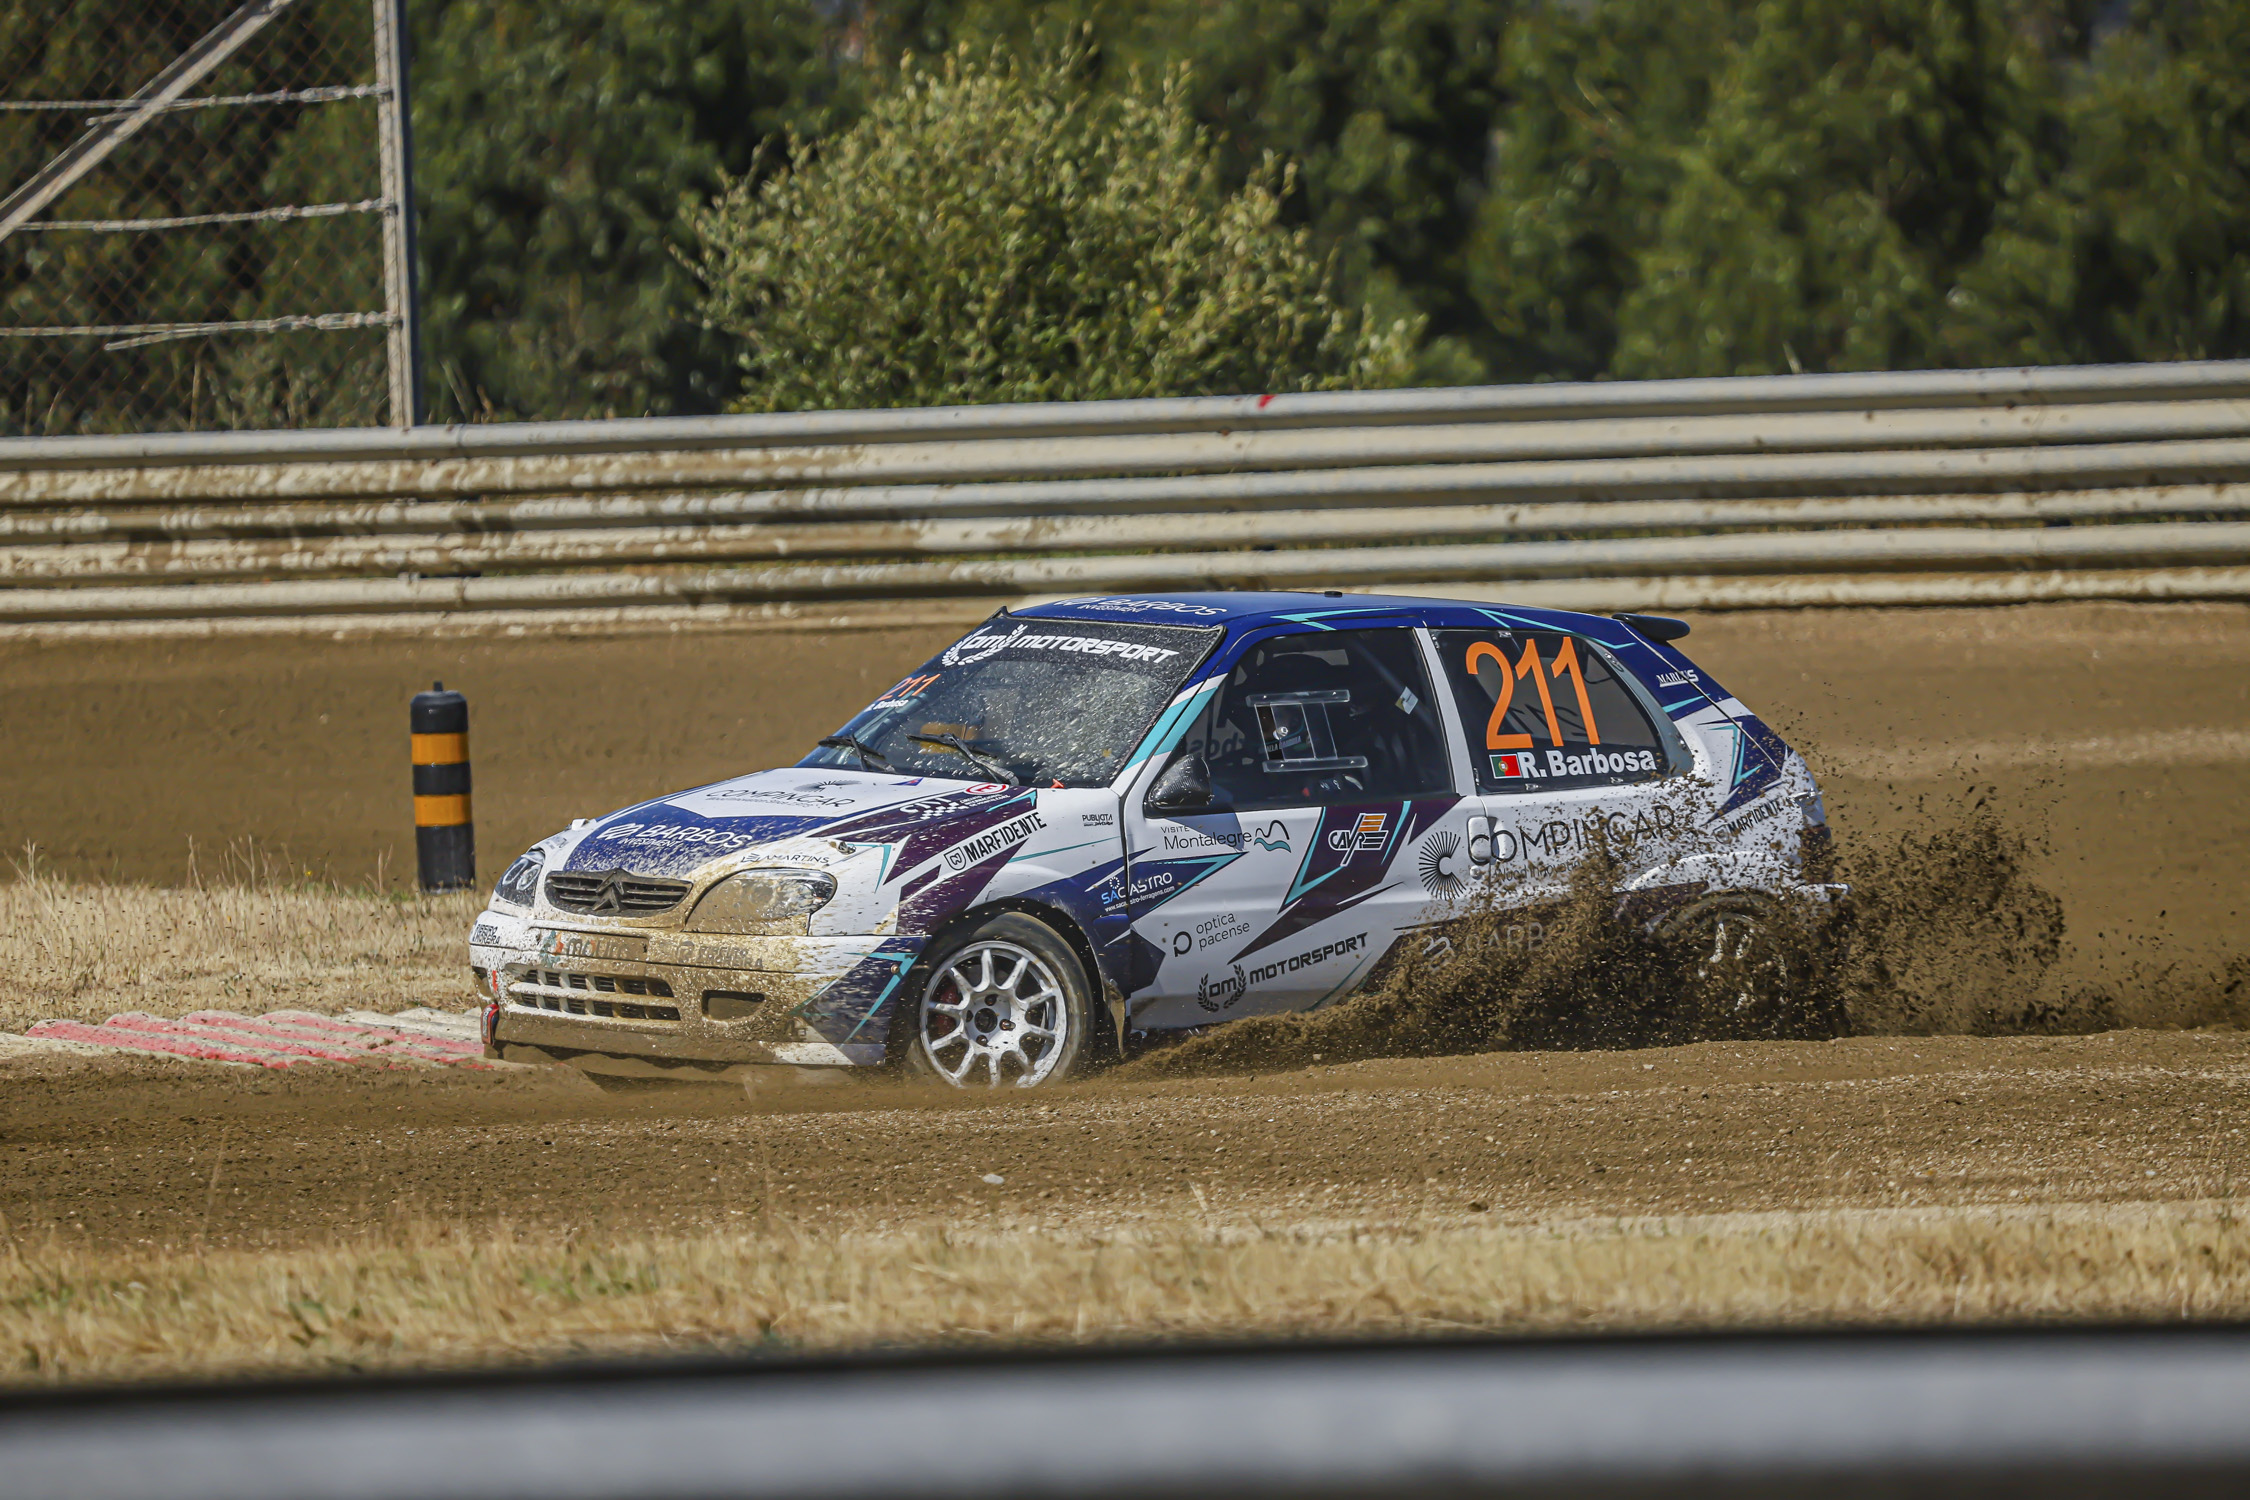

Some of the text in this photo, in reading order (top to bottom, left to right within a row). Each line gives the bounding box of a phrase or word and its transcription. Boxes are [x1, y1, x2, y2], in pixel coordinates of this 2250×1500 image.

[1010, 634, 1180, 664] MOTORSPORT
[1465, 636, 1600, 750] 211
[1517, 748, 1658, 779] R. Barbosa
[634, 824, 752, 848] BARBOS
[962, 811, 1047, 863] MARFIDENTE
[1160, 825, 1190, 834] VISITE
[1163, 831, 1252, 850] Montalegre
[1196, 912, 1236, 935] optica
[1198, 920, 1251, 951] pacense
[1249, 931, 1369, 985] MOTORSPORT
